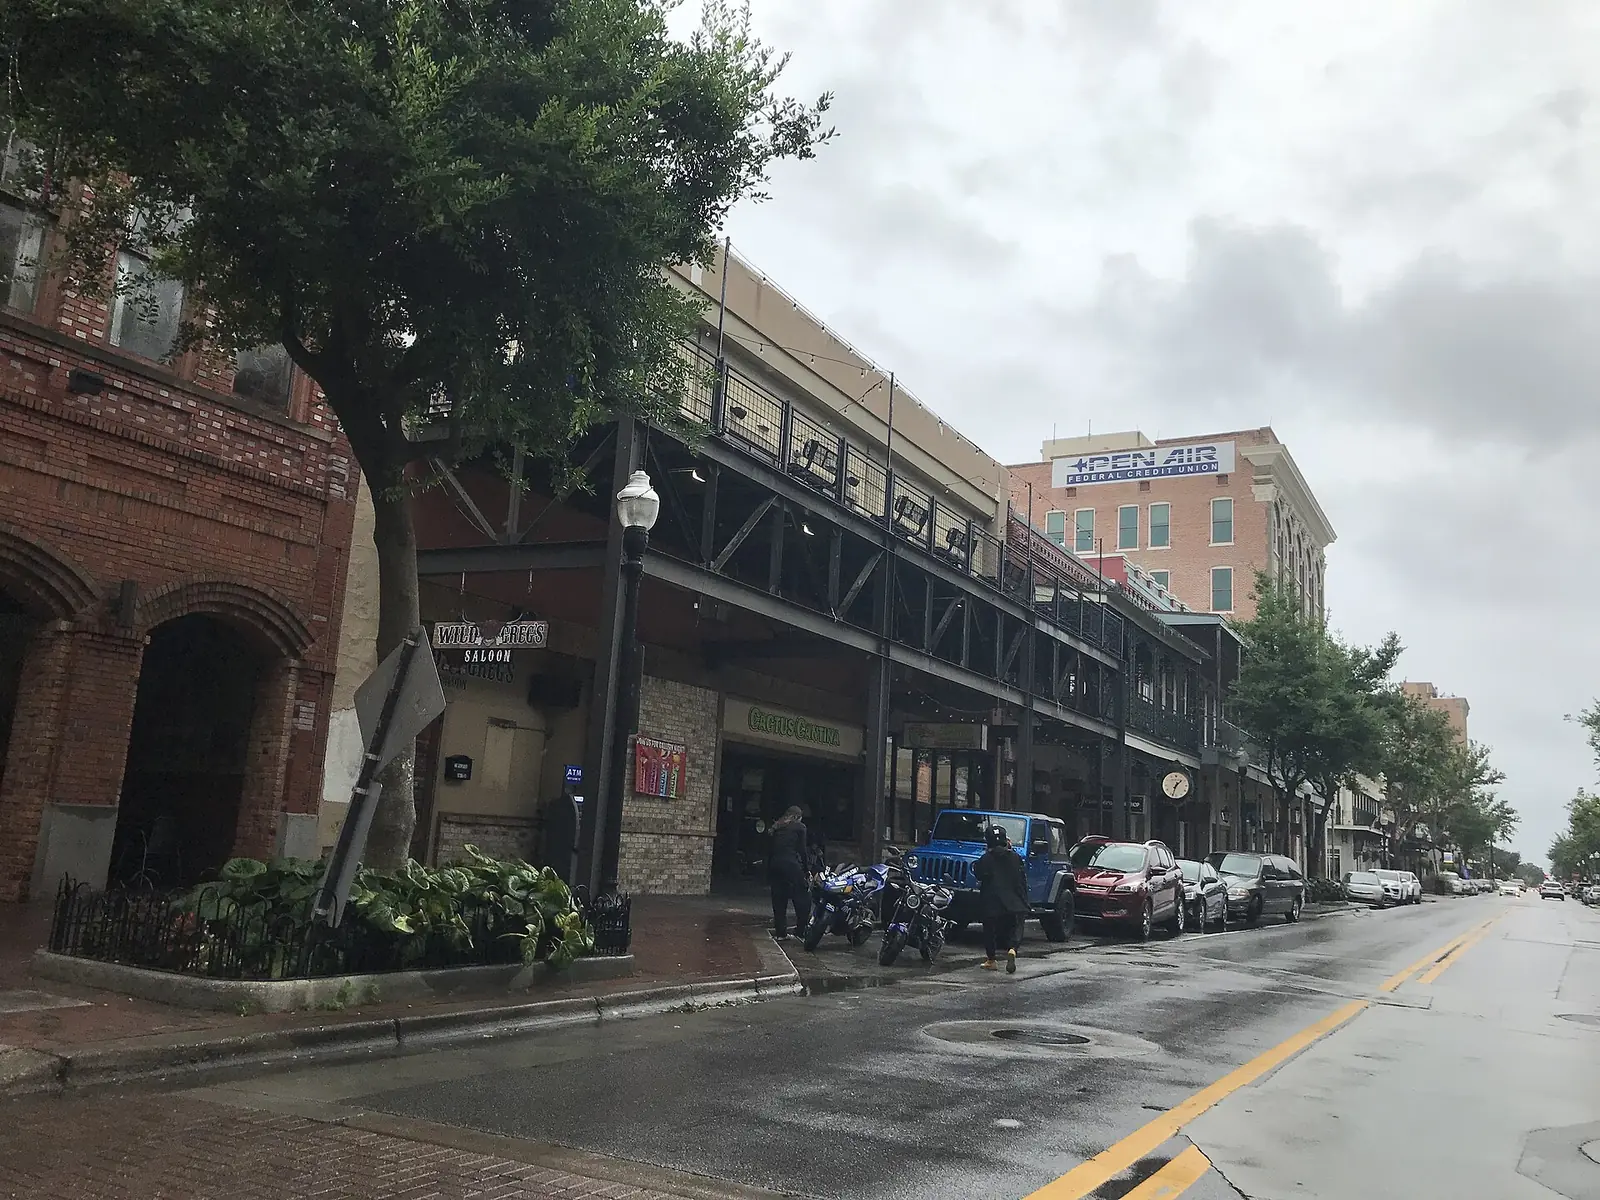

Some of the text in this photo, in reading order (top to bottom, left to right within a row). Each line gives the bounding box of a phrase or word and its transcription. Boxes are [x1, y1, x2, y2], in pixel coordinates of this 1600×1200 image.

[1089, 445, 1218, 471] PEN AIR
[1068, 462, 1218, 484] FEDERAL CREDIT UNION
[438, 623, 545, 645] WILD GREG'S
[464, 649, 511, 663] SALOON
[749, 706, 840, 747] CACTUS CANTINA
[566, 768, 582, 777] ATM
